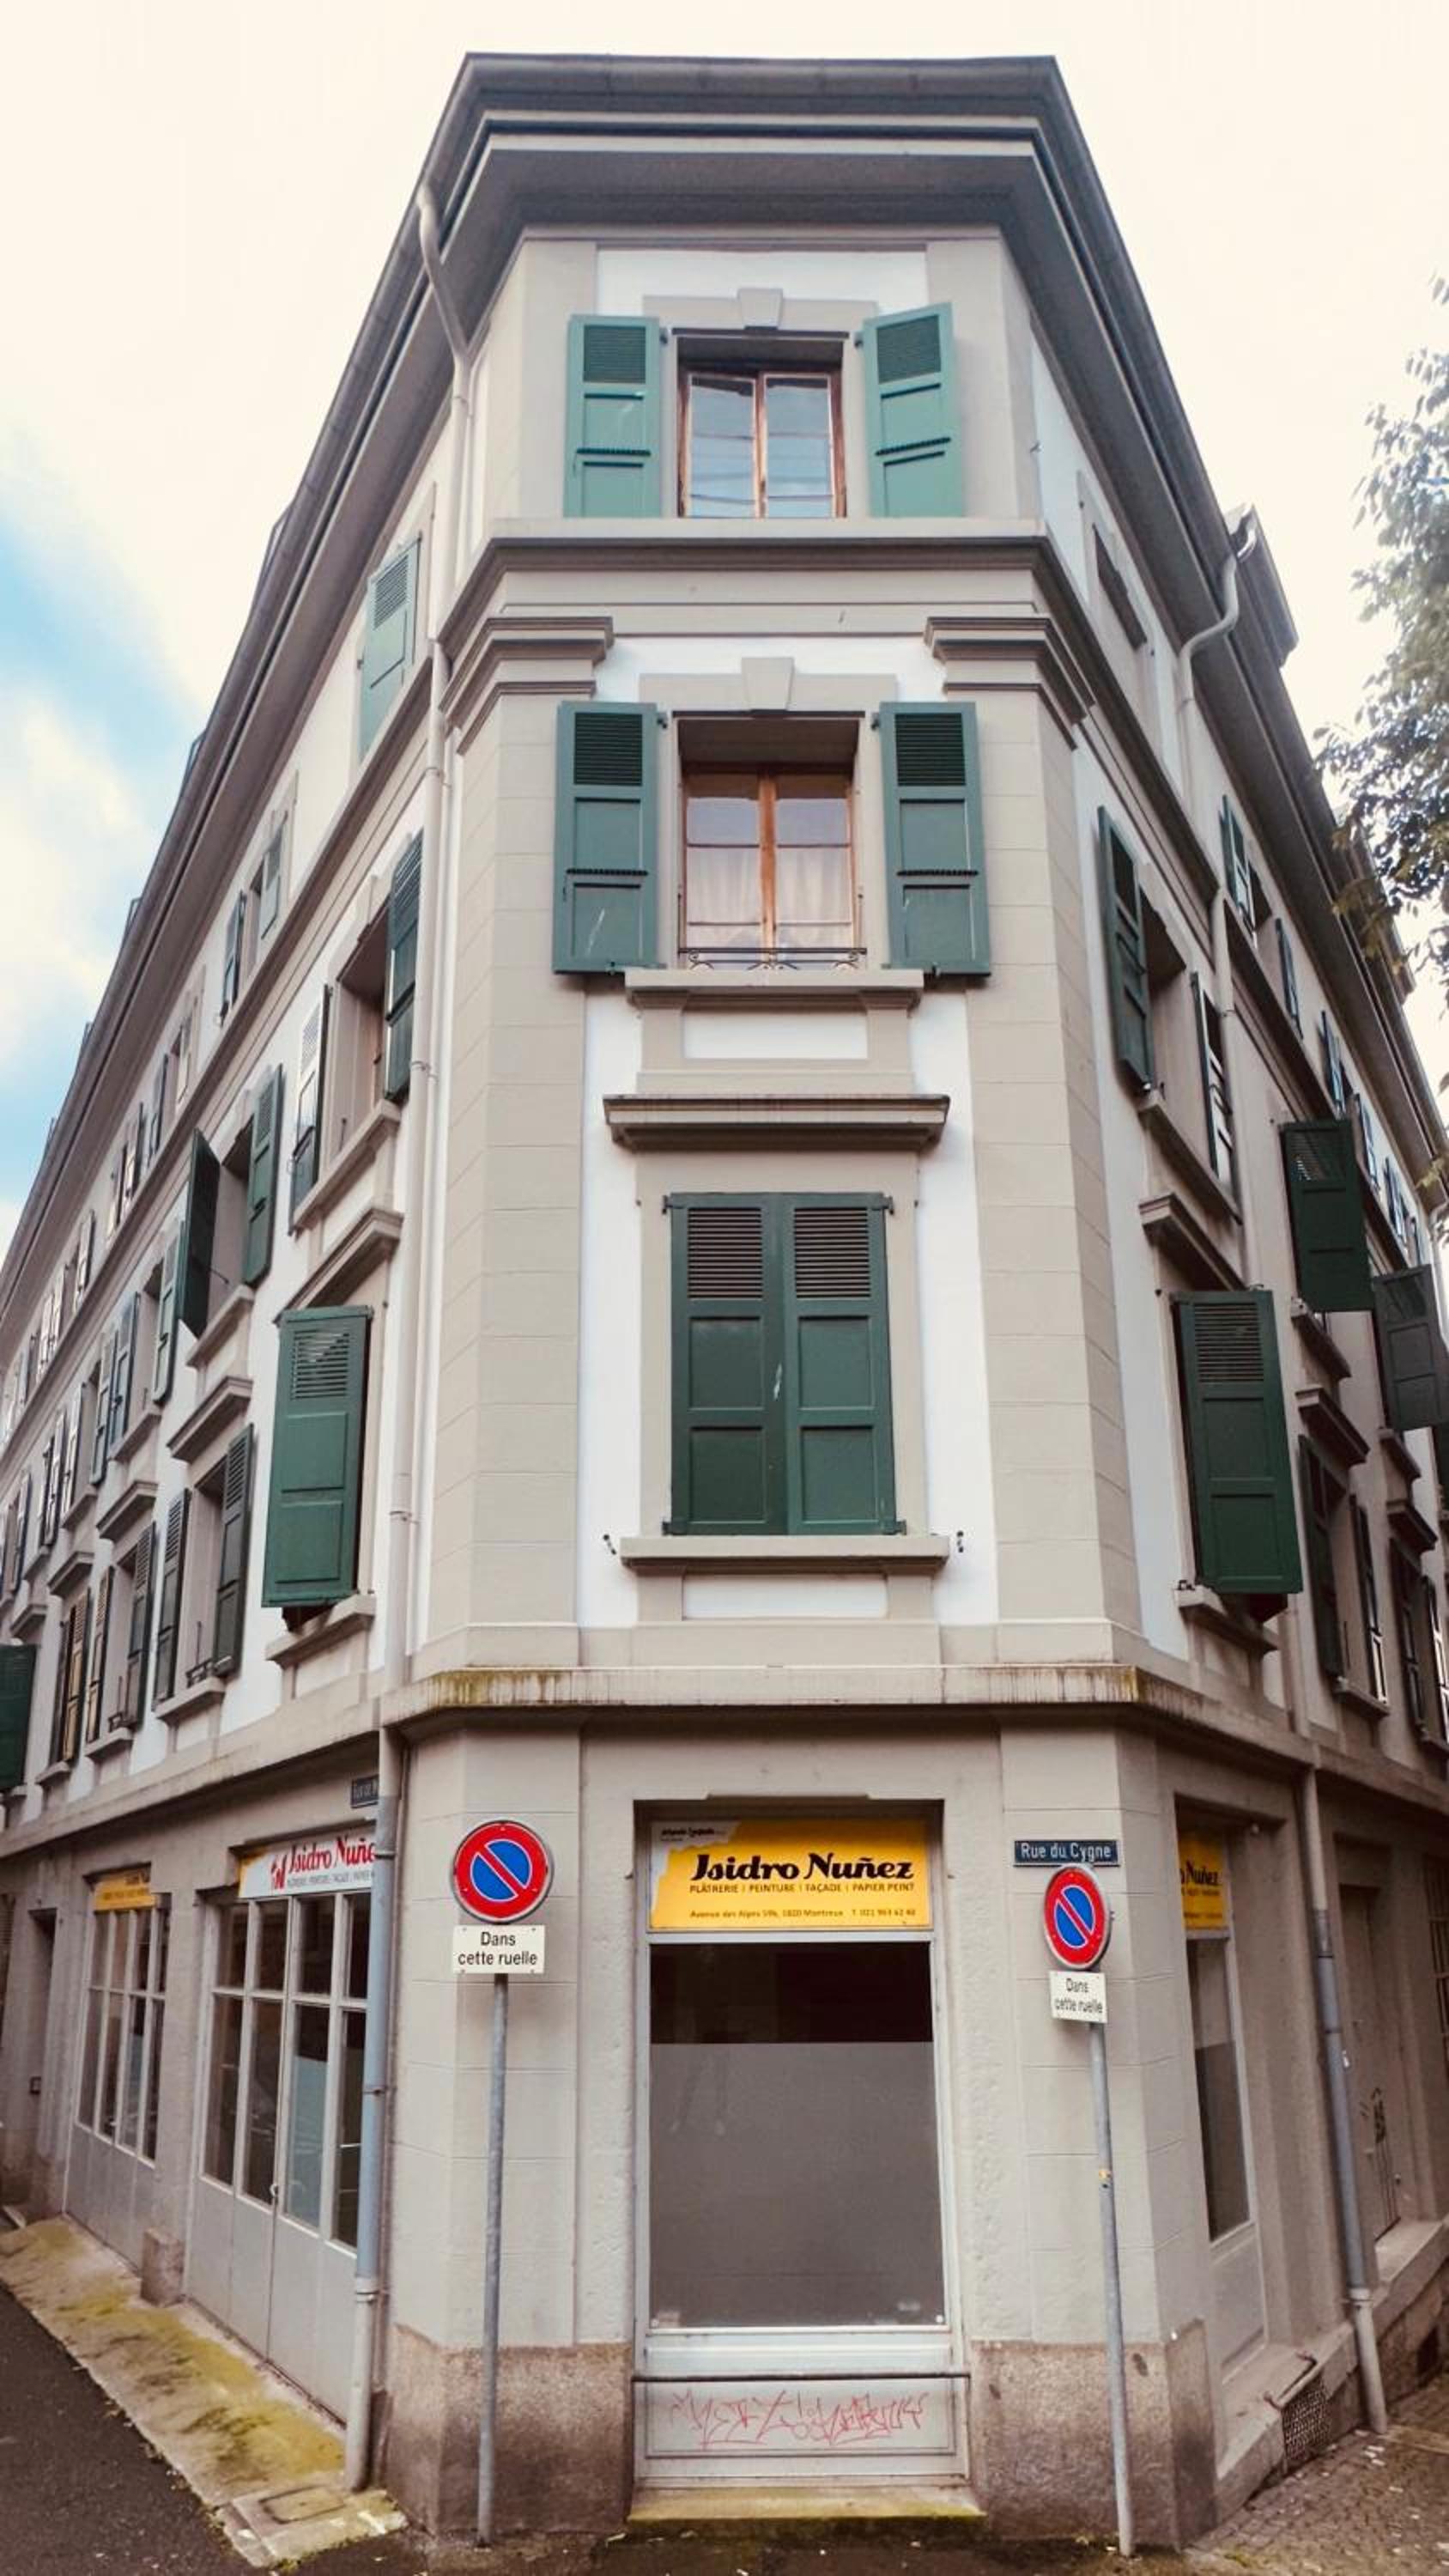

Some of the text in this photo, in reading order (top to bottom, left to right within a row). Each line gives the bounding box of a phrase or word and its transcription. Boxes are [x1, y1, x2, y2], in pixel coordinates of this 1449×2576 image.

[289, 1842, 331, 1873] Isidro
[333, 1834, 375, 1866] Nuñe
[1021, 1842, 1111, 1862] Rue du Cygne
[690, 1852, 914, 1880] Isidro Nuñez
[689, 1881, 914, 1893] PLÂTRERIE PEINTURE FAÇADE PAPIER PEINT
[481, 1931, 516, 1947] Dans
[458, 1951, 537, 1965] cette ruelle
[1065, 1978, 1088, 1993] Dans
[1055, 1997, 1103, 2014] cette ruelle
